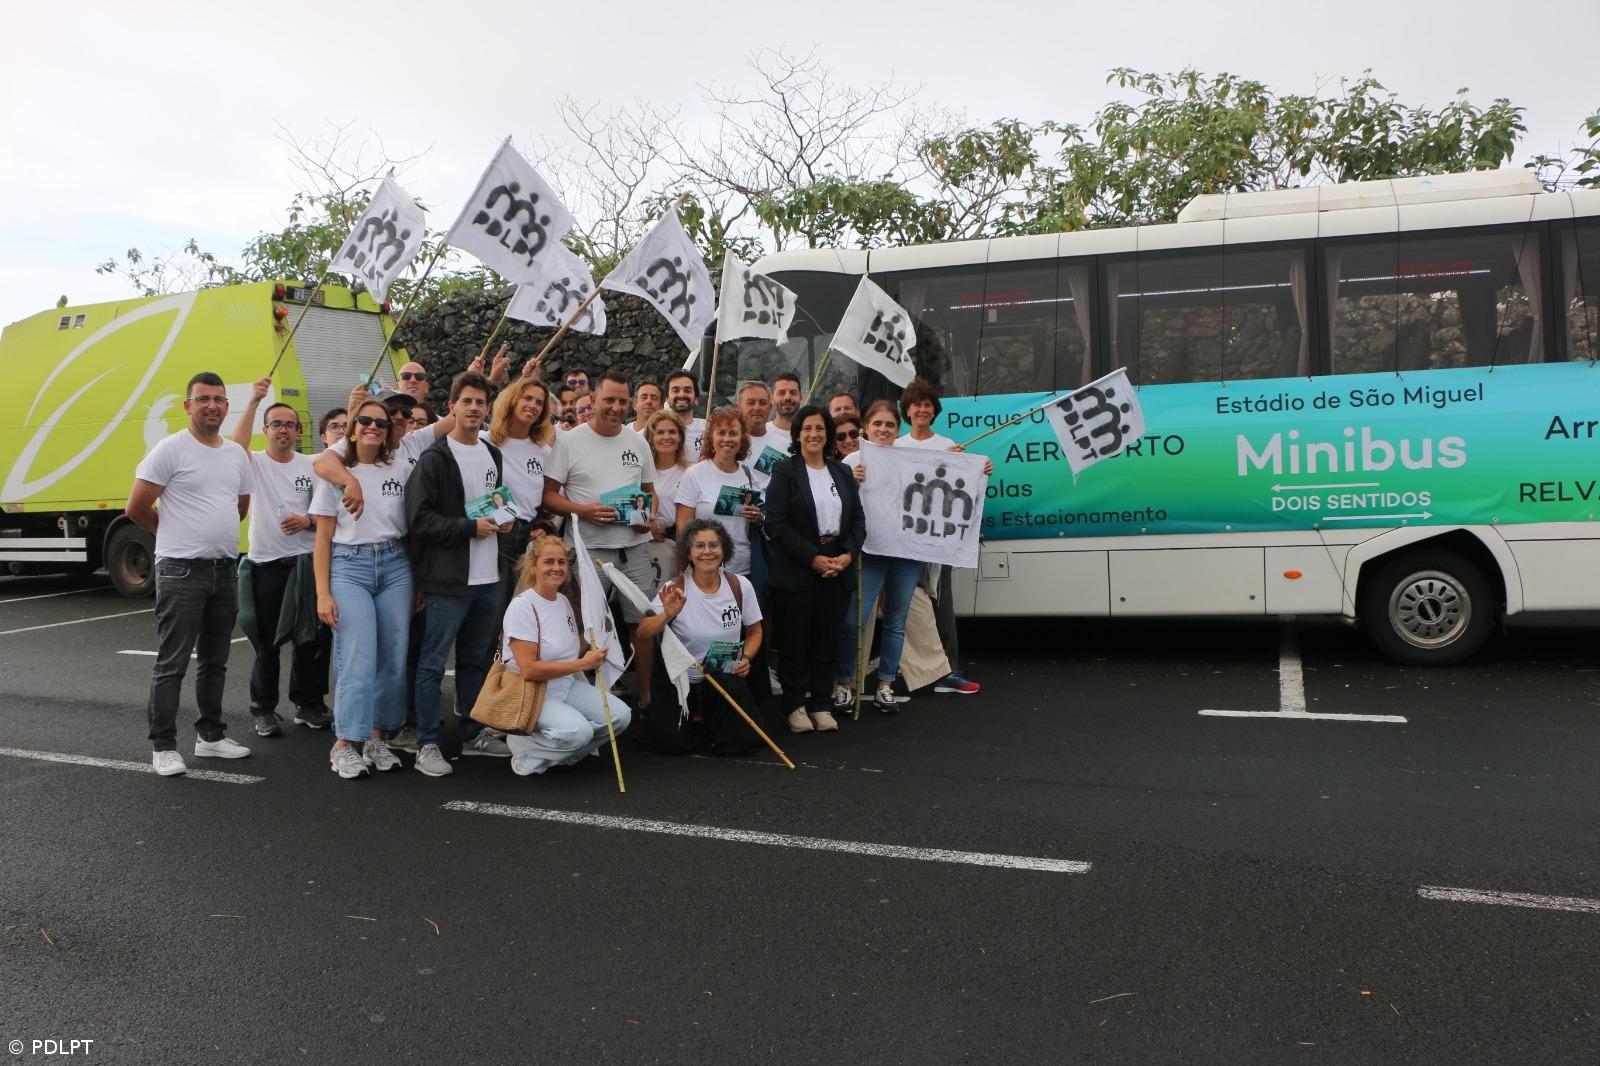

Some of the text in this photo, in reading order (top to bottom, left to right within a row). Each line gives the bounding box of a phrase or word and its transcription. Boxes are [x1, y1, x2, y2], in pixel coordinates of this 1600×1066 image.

[1216, 383, 1484, 414] Estádio de São Miguel
[948, 409, 1022, 430] Parque
[1056, 398, 1098, 460] PDLPT
[1005, 434, 1185, 464] AERRTO
[1237, 427, 1467, 477] Minibus
[985, 479, 1033, 499] olas
[1271, 491, 1432, 512] DOIS SENTIDOS
[1519, 480, 1600, 503] RELV
[902, 514, 970, 541] PDLPT
[1002, 507, 1167, 528] Estacionamento
